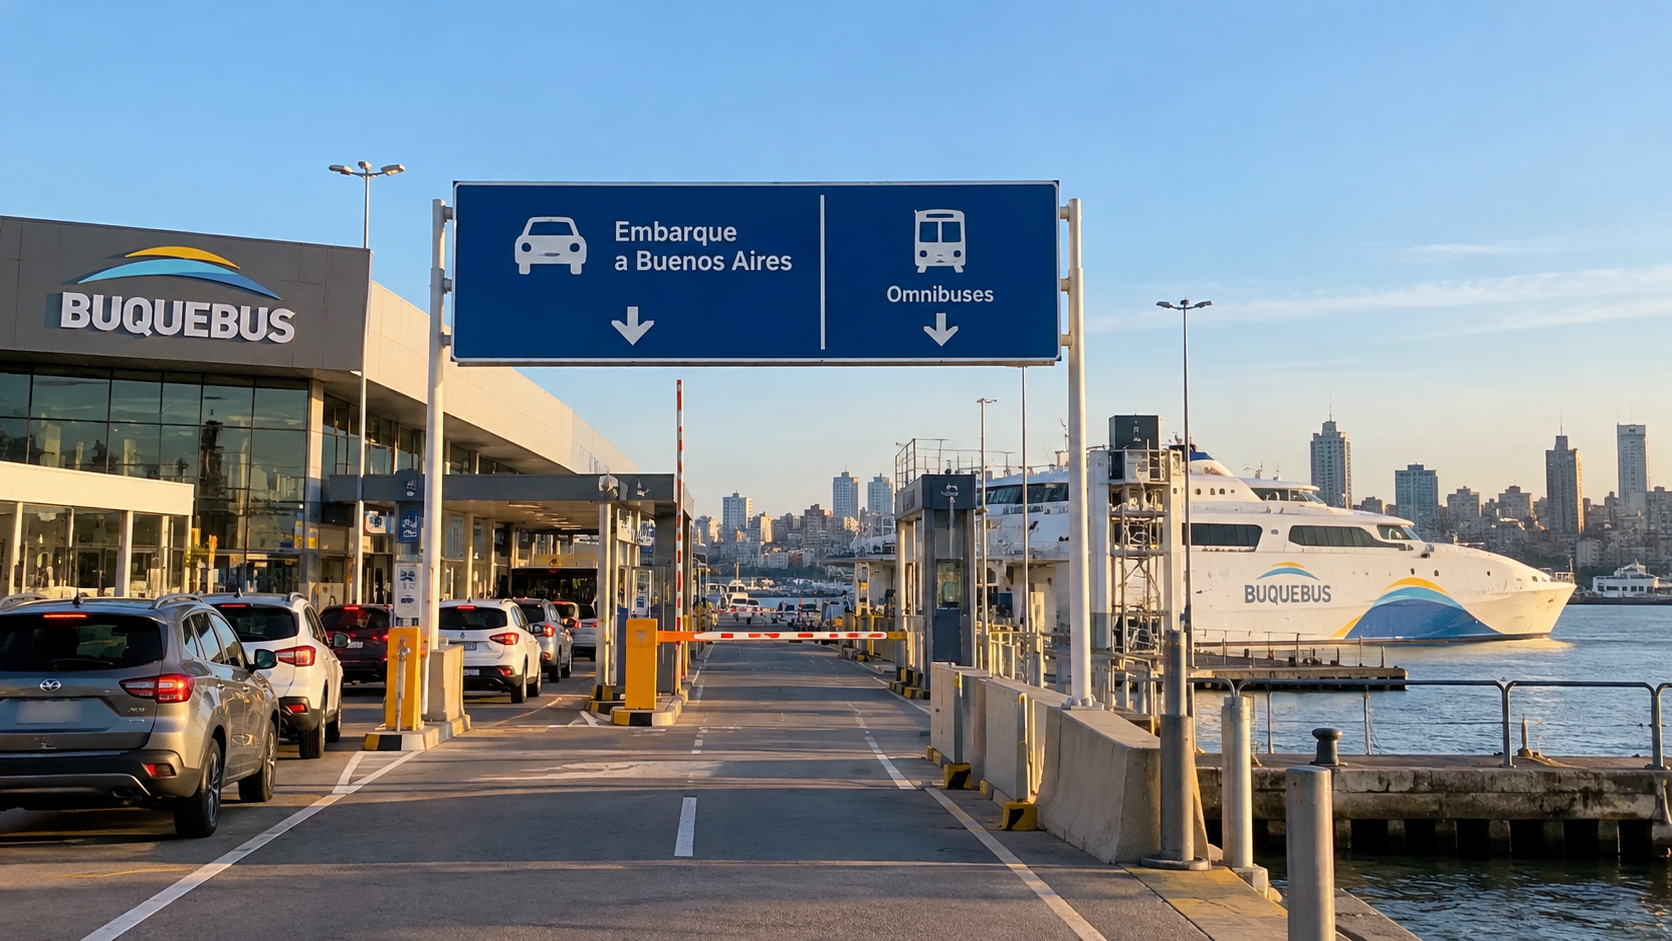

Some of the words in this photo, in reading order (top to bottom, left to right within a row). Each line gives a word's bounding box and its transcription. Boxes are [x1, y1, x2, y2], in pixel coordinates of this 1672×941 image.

[615, 220, 737, 246] Embarque
[614, 255, 628, 271] a
[636, 250, 725, 271] Buenos
[731, 250, 793, 271] Aires
[886, 285, 994, 303] Omnibuses
[60, 291, 296, 344] BUQUEBUS
[1244, 584, 1332, 606] BUQUEBUS
